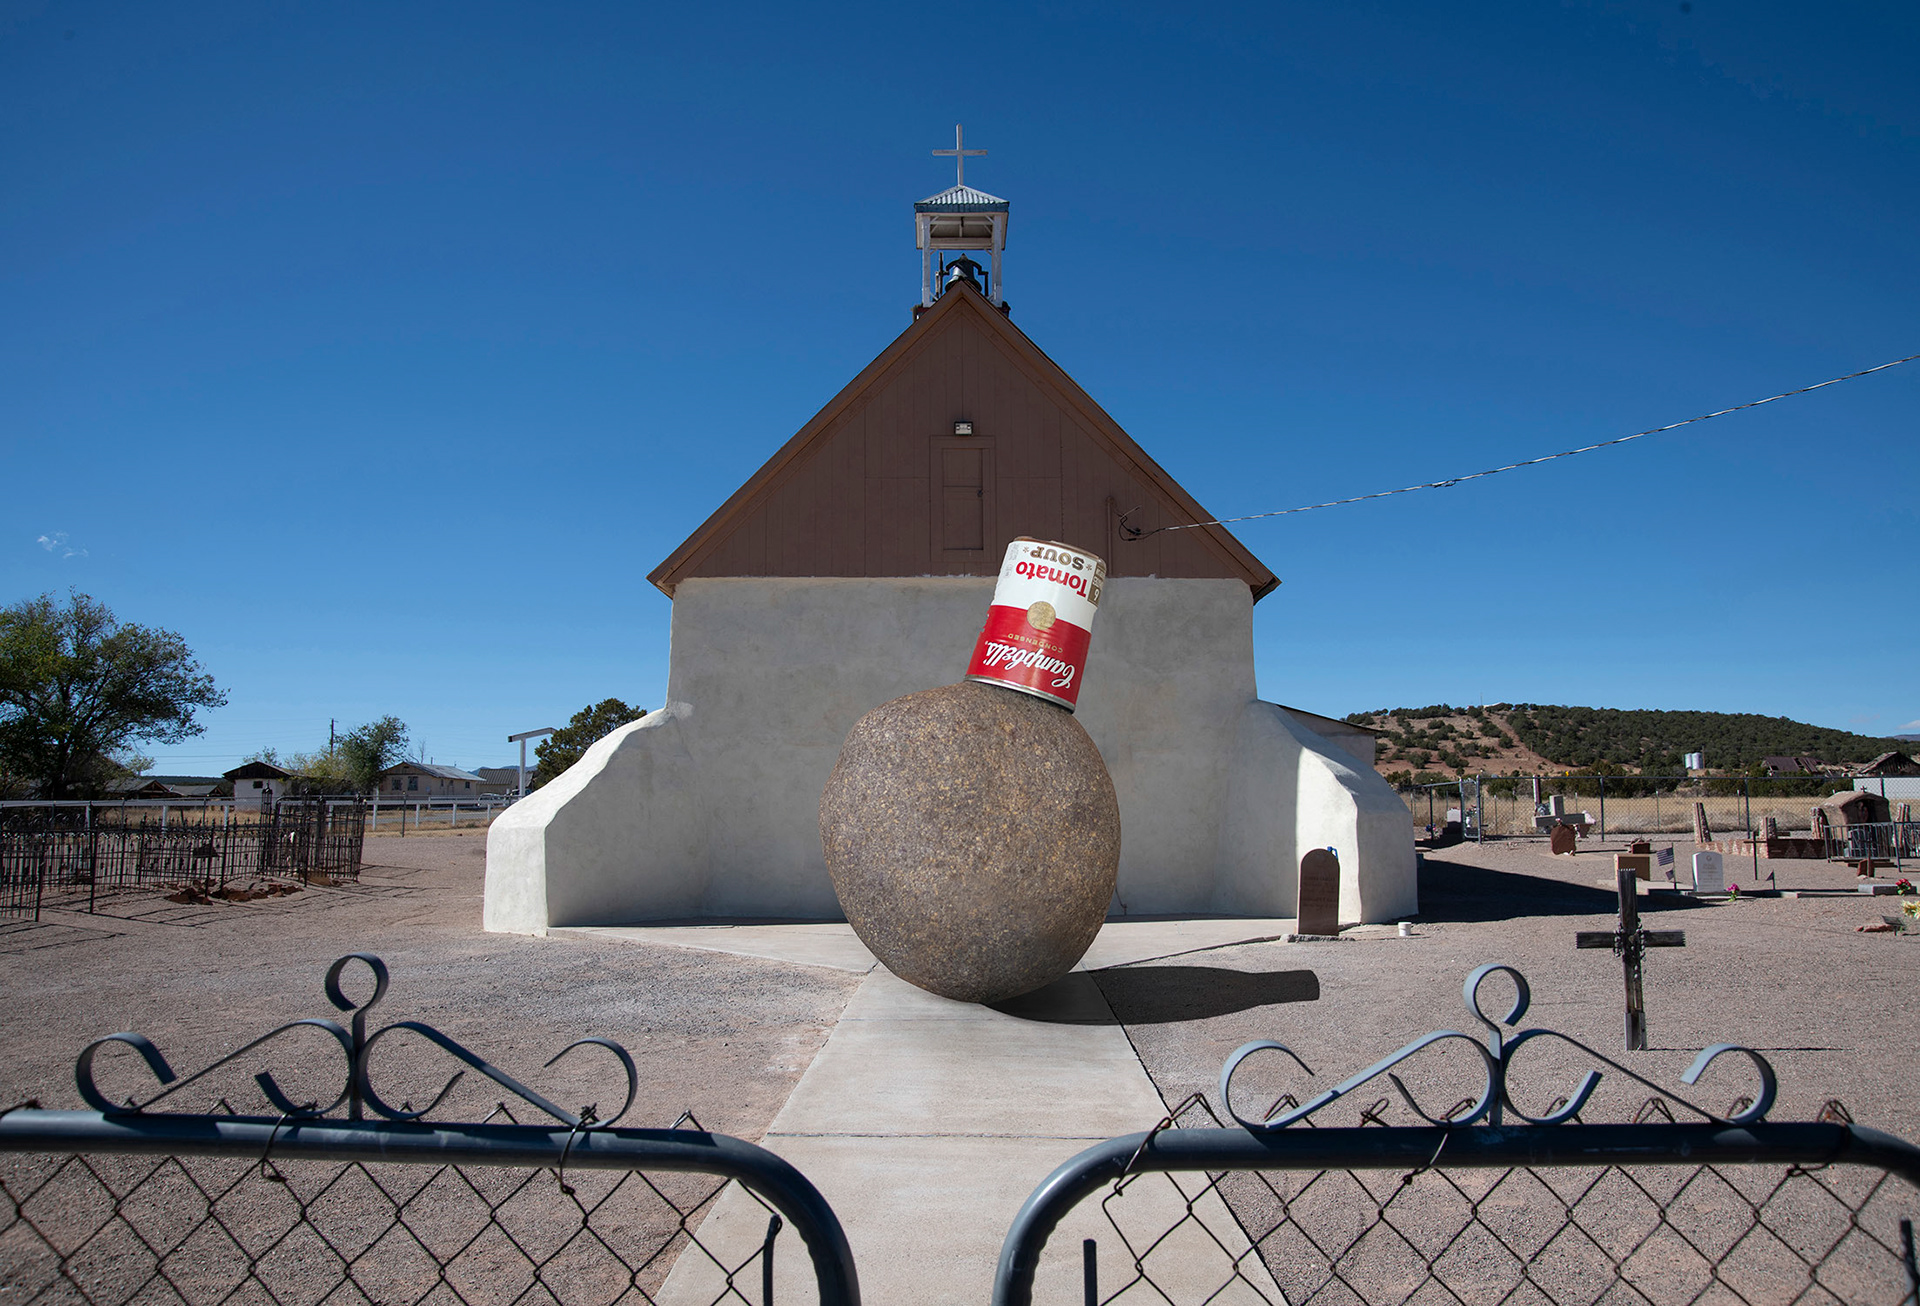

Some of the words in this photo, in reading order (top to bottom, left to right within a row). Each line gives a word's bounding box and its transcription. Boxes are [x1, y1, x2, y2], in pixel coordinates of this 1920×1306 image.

[1029, 546, 1085, 571] SOUP
[1015, 561, 1088, 598] Tomato
[1007, 633, 1064, 654] CONDENSED
[983, 641, 1075, 689] Campbell's
